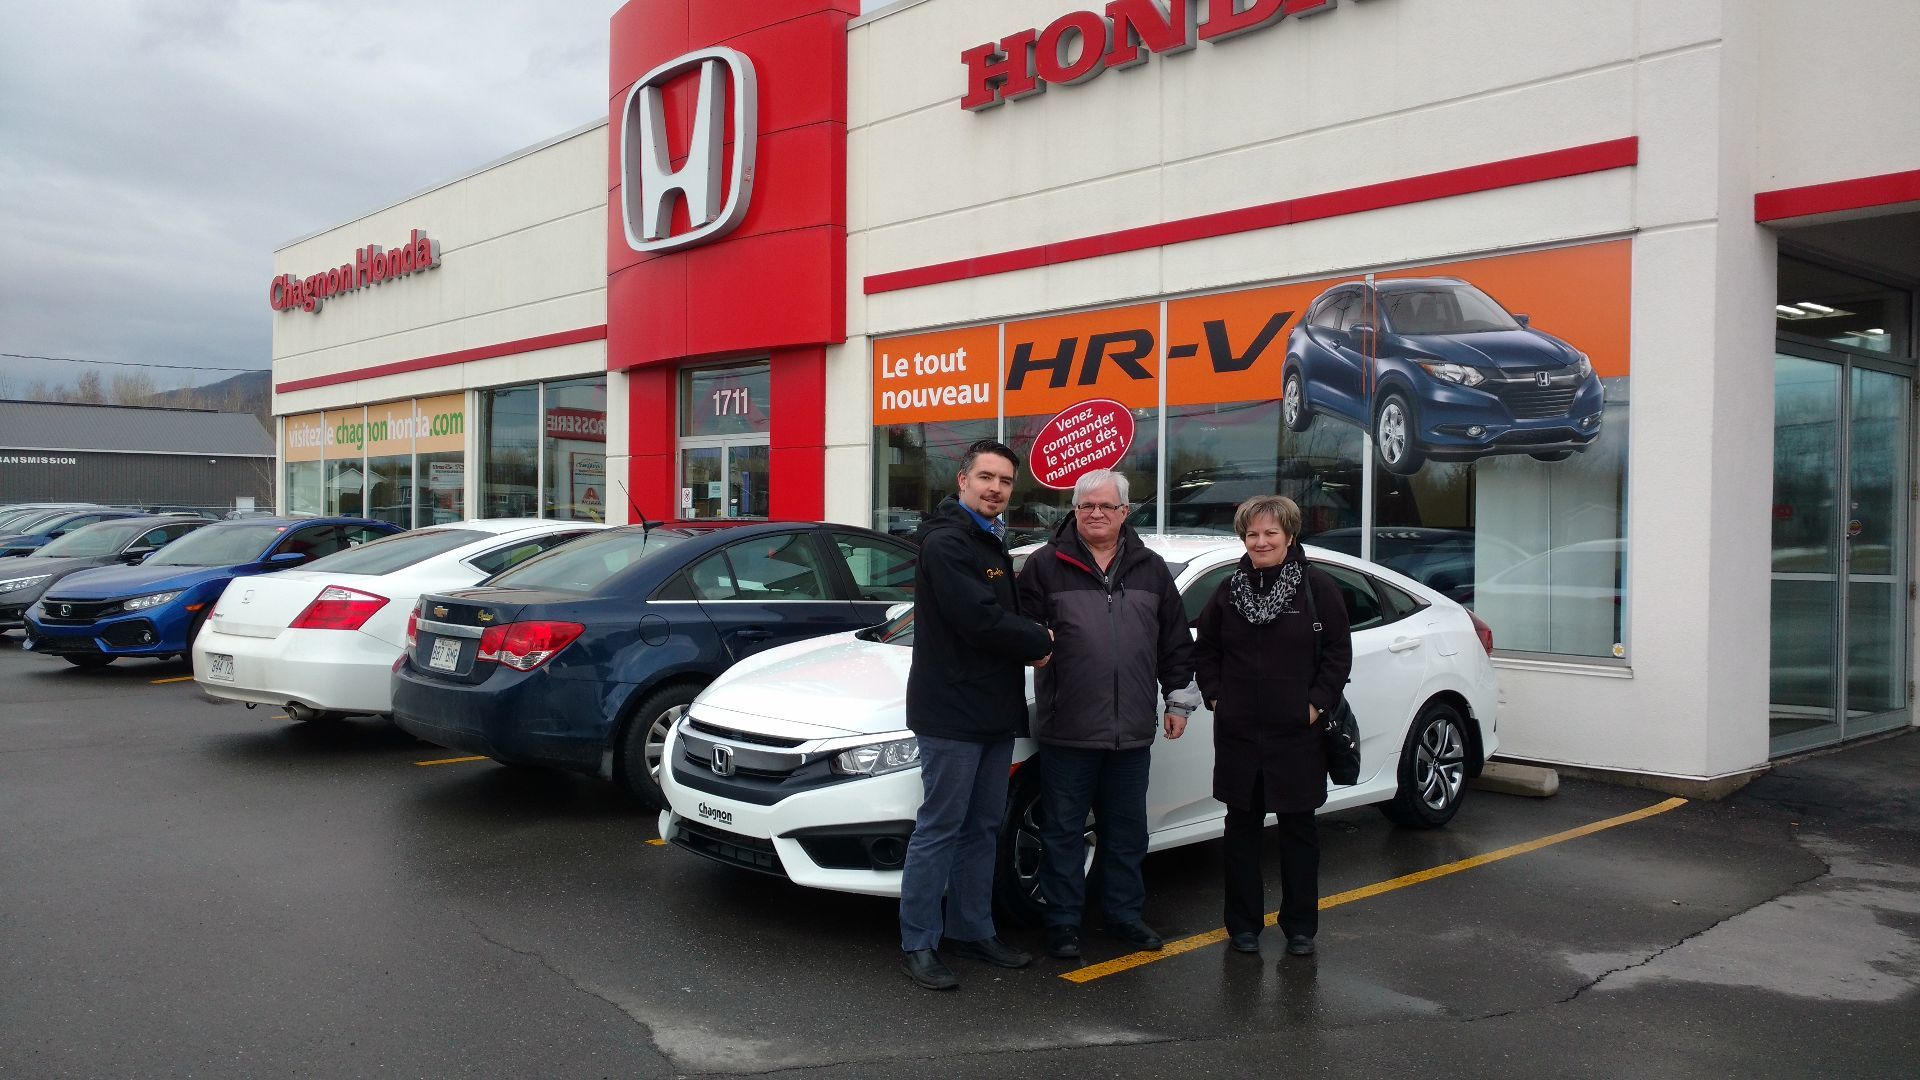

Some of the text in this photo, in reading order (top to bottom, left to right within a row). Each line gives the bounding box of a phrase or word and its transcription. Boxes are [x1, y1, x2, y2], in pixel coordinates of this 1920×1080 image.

[961, 0, 1338, 111] HOND
[270, 229, 434, 313] Chagnon Honda
[881, 347, 967, 379] Le tout
[1004, 310, 1296, 391] HR-V
[712, 387, 748, 416] 1711
[881, 382, 990, 410] nouveau
[288, 422, 321, 448] visitez
[324, 419, 334, 446] le
[1042, 411, 1115, 455] commander
[1056, 407, 1094, 432] Venez
[0, 456, 76, 465] ANSMISSION
[1045, 435, 1125, 482] maintenant !
[1046, 427, 1118, 468] le vôtre dès
[698, 801, 733, 821] Chagnon
